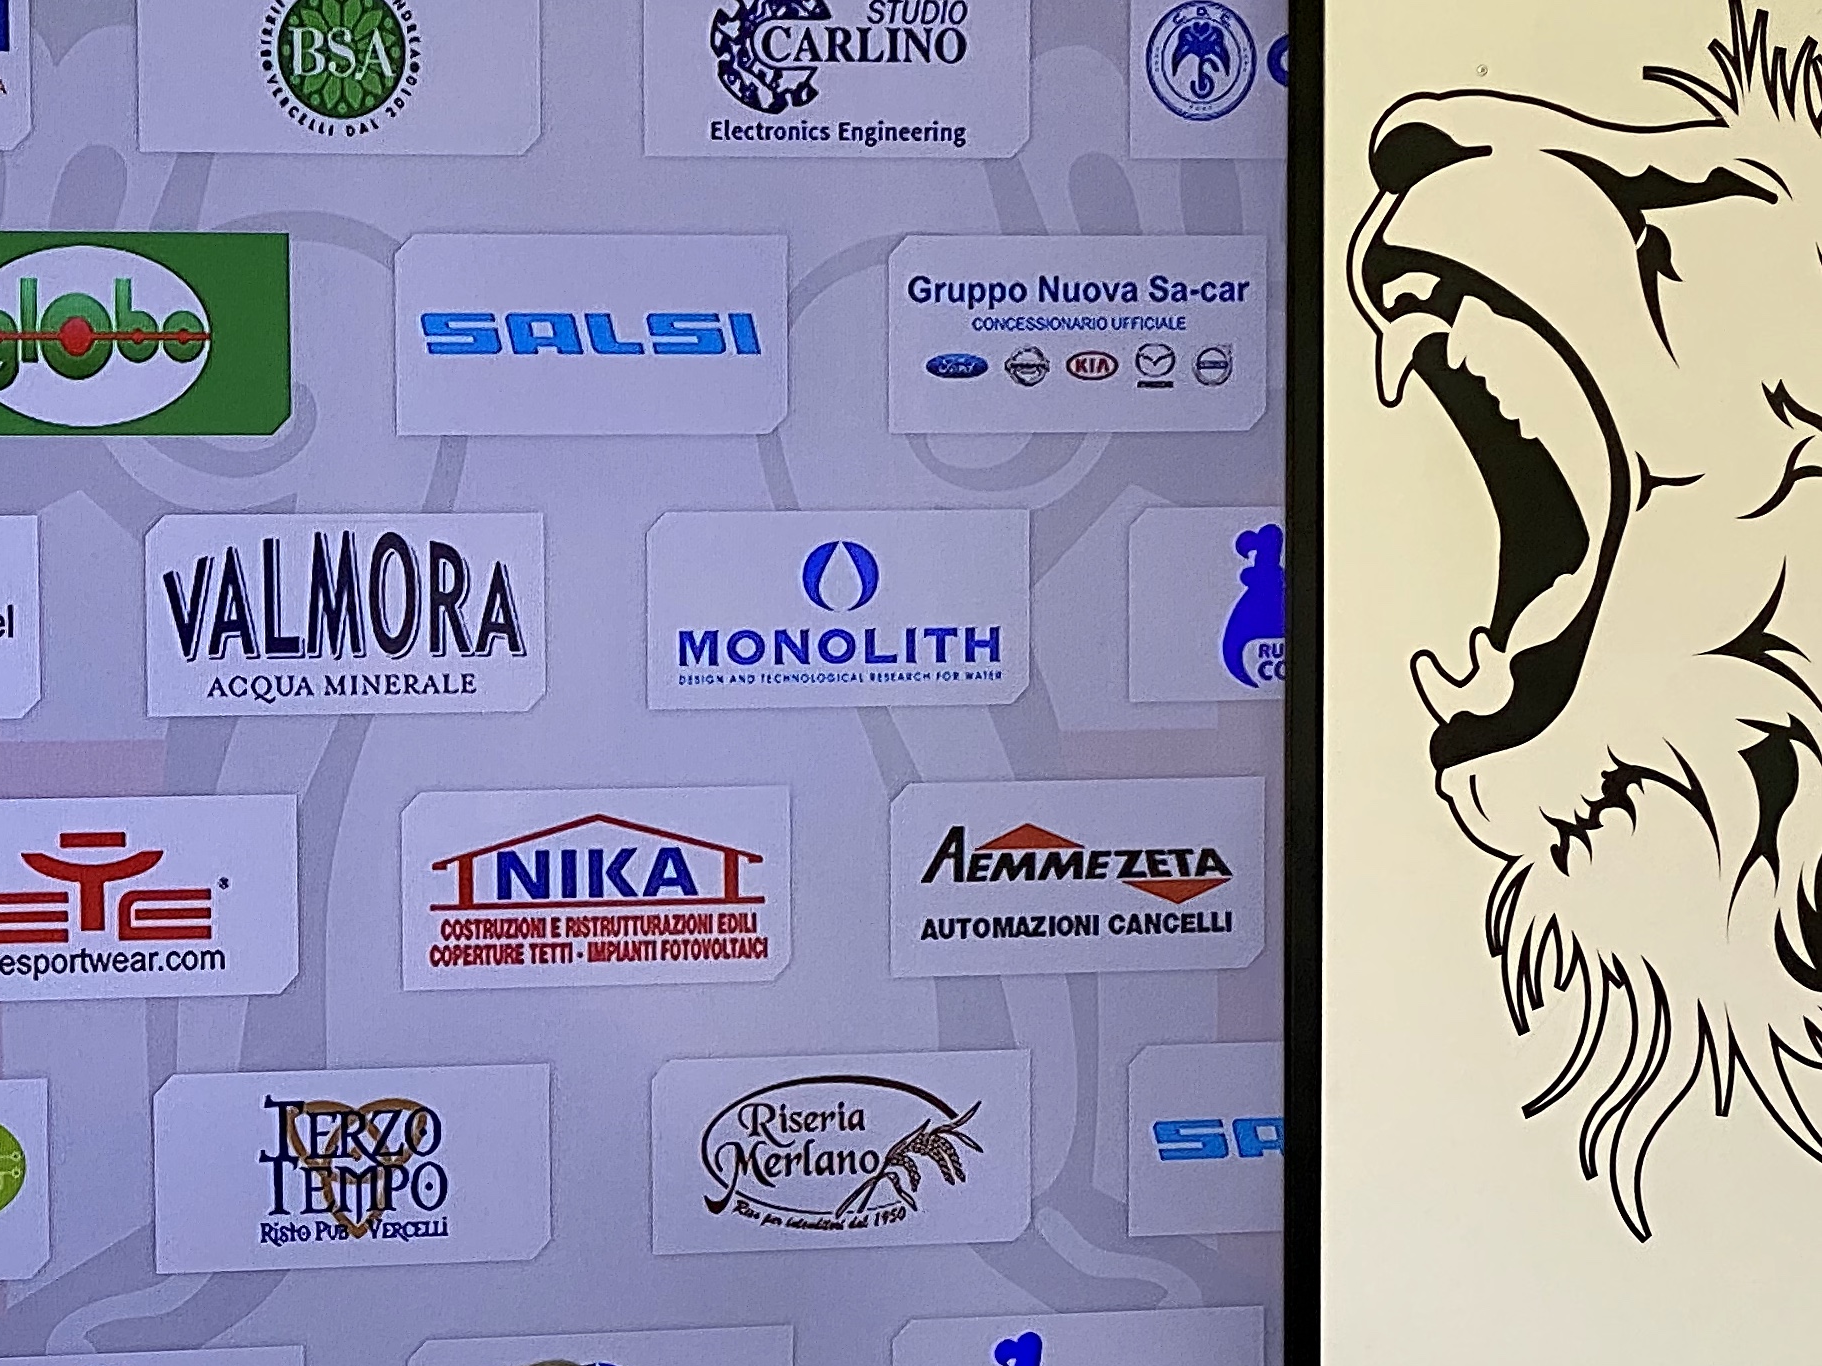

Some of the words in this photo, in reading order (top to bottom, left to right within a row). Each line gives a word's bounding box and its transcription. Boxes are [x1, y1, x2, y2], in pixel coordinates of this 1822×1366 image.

[867, 0, 968, 25] STUDIO
[289, 26, 396, 80] BSA
[762, 25, 968, 64] CARLINO
[710, 120, 830, 141] Electronics
[839, 121, 966, 148] Engineering
[908, 275, 1028, 310] Gruppo
[1038, 275, 1138, 303] Nuova
[1148, 275, 1250, 303] Sa-car
[421, 312, 761, 355] SALSI
[972, 316, 1108, 332] CONCESSIONARIO
[1111, 316, 1187, 332] UFFICIALE
[1075, 357, 1111, 373] KIA
[163, 529, 528, 663] VALMORA
[678, 626, 1001, 667] MONOLITH
[207, 673, 315, 704] ACQUA
[324, 673, 477, 698] MINERALE
[496, 847, 699, 901] NIKA
[920, 825, 1233, 884] AEMMEZETA
[440, 917, 547, 941] COSTRUZIONI
[551, 916, 561, 938] E
[565, 914, 713, 938] RISTRUTTURAZIONI
[717, 912, 757, 934] EDILI
[921, 914, 1100, 941] AUTOMAZIONI
[1108, 911, 1233, 936] CANCELLI
[430, 943, 525, 967] COPERTURE
[529, 942, 573, 964] TETTI
[587, 939, 657, 962] IMPIANTI
[661, 937, 768, 961] FOTOVOLTAICI
[264, 1094, 442, 1162] TERZO
[738, 1101, 865, 1147] Riseria
[259, 1150, 448, 1218] TEMPO
[704, 1139, 879, 1214] Merlano
